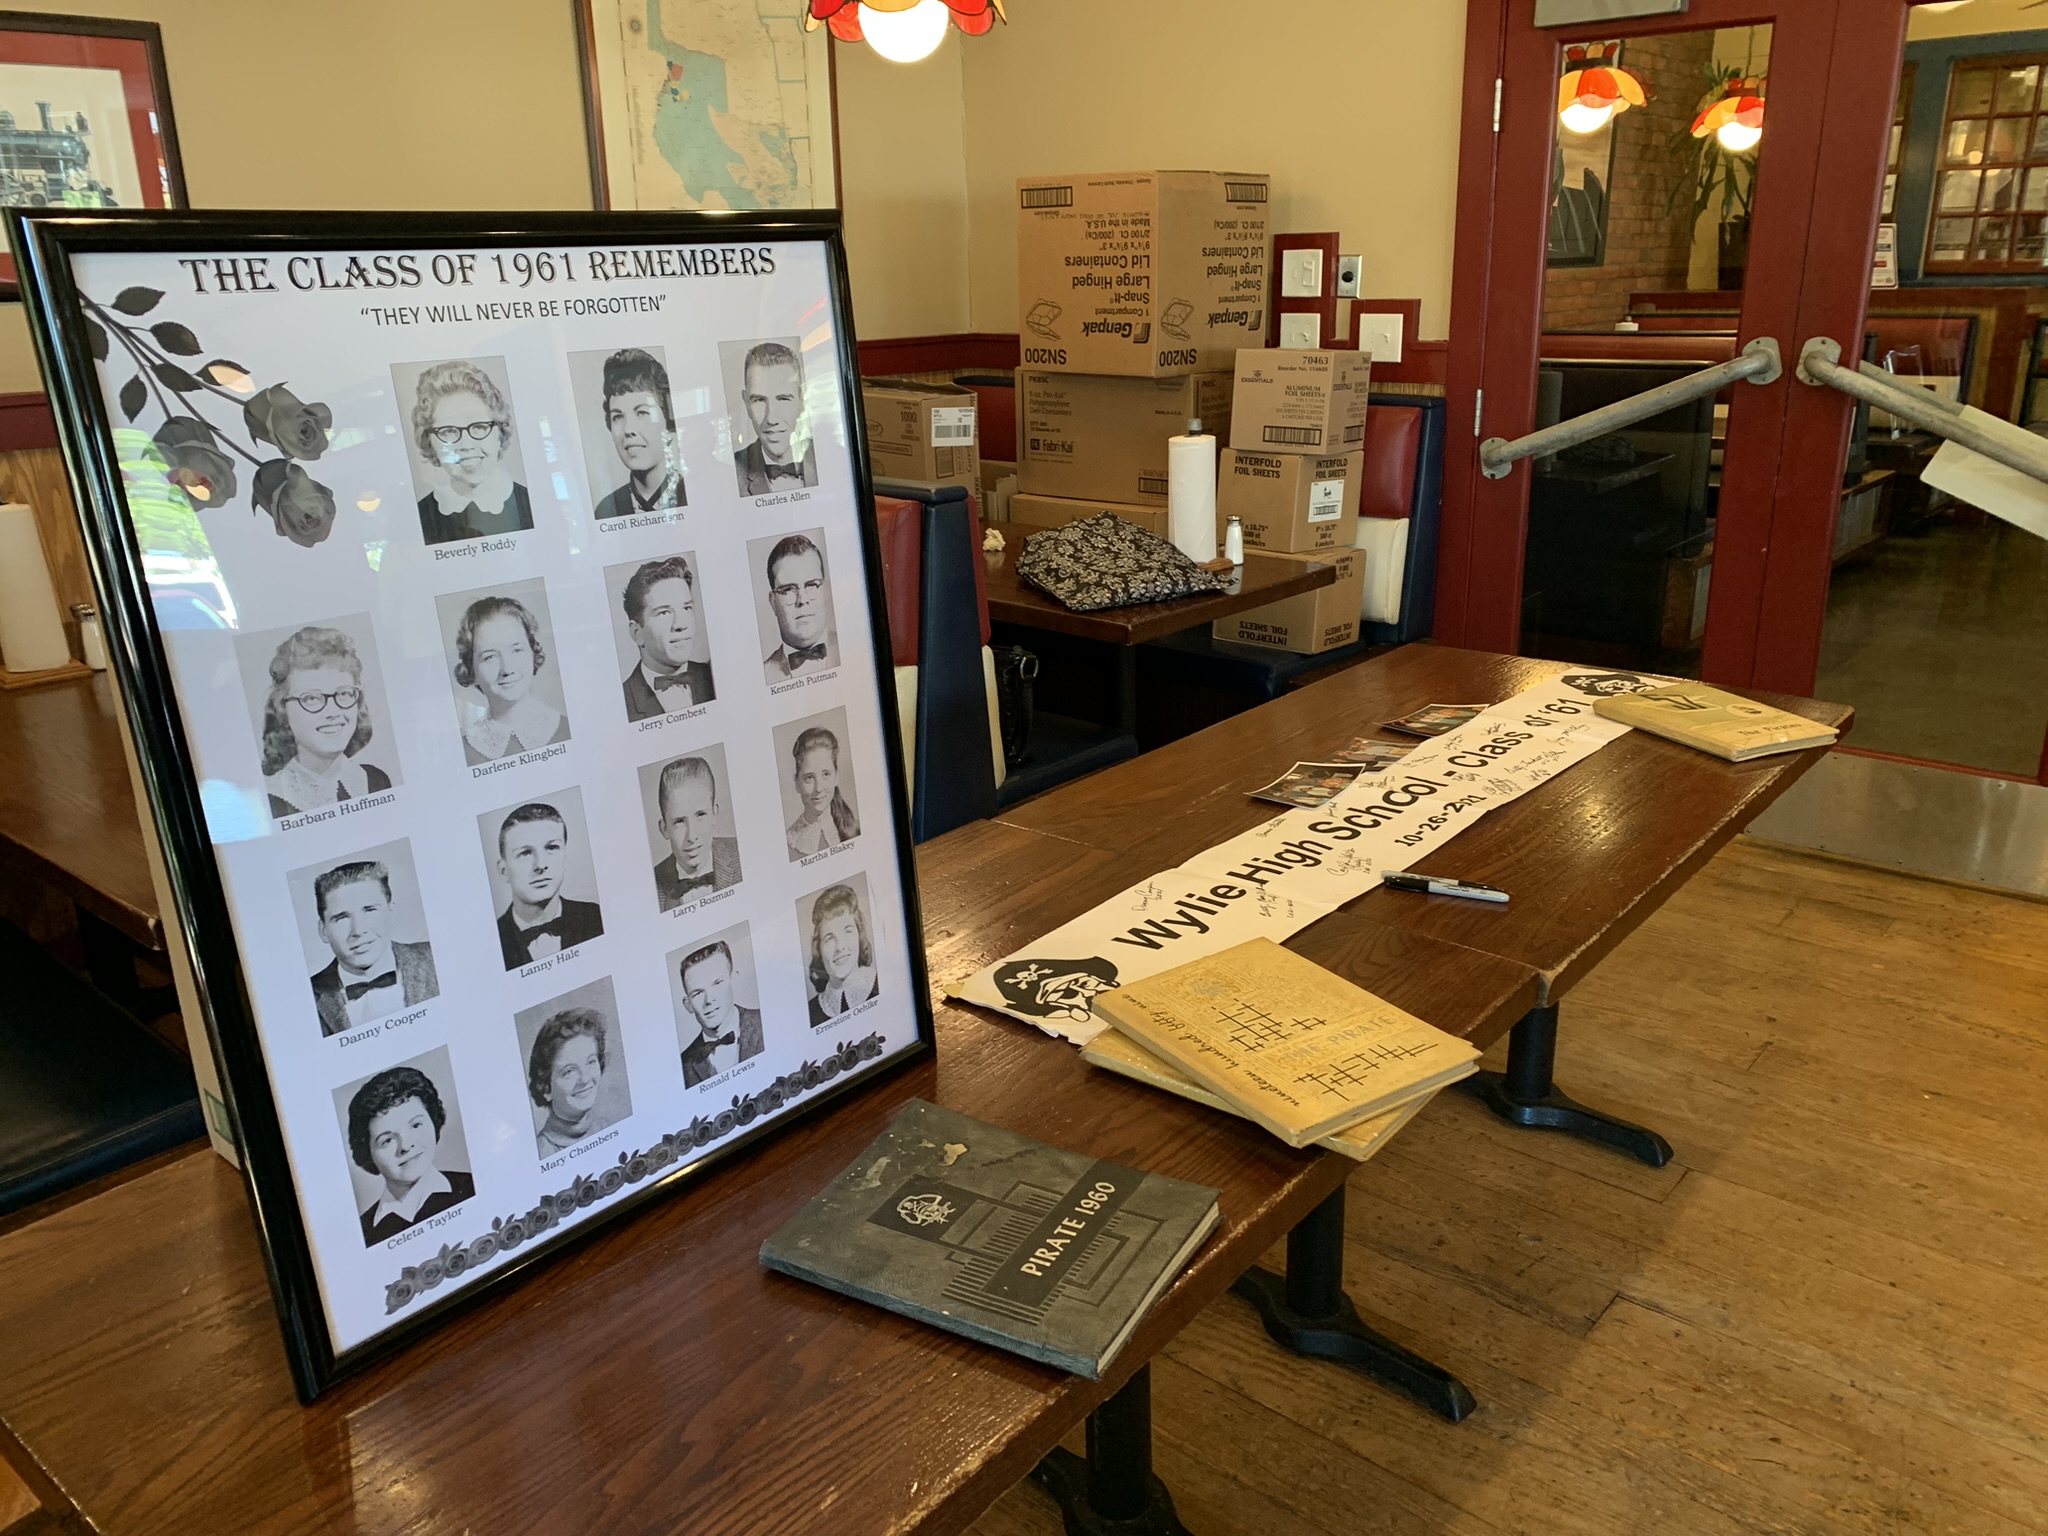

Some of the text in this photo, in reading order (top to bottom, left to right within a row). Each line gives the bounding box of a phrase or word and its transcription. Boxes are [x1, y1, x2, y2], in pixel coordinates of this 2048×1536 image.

[1108, 219, 1120, 227] the
[1121, 219, 1129, 227] in
[1130, 218, 1150, 227] Made
[1130, 230, 1150, 239] 2/100
[1064, 254, 1150, 269] Lid Containers
[1202, 246, 1264, 259] Lid Containers
[178, 247, 777, 294] THE CLASS OF 1961 REMEMBERS
[1207, 264, 1263, 278] Large Hinged
[1072, 275, 1150, 290] Large Hinged
[1218, 295, 1257, 305] Compartment
[361, 294, 667, 327] “THEY WILL NEVER BE FORGOTTEN”
[1095, 306, 1150, 318] 1 Compartment
[1208, 310, 1248, 328] Genpak
[1082, 321, 1133, 338] Genpak
[1024, 348, 1068, 366] SN200
[1159, 349, 1197, 367] SN200
[1302, 356, 1329, 365] 70463
[1042, 407, 1072, 416] Containers
[1235, 456, 1281, 468] INTERFOLD
[1316, 458, 1348, 469] INTERFOLD
[1234, 466, 1280, 479] FOIL SHEETS
[1315, 469, 1347, 479] FOIL SHEETS
[755, 491, 811, 508] Charles Allen
[599, 510, 685, 534] Carol Richardson
[434, 537, 517, 562] Beverly Roddy
[1239, 620, 1288, 636] FOIL SHEETS
[1324, 622, 1352, 637] FOIL SHEETS
[1238, 631, 1287, 646] INTERFOLD
[1323, 632, 1352, 647] INTERFOLD
[769, 670, 838, 696] Kenneth Putman
[638, 706, 707, 733] Jerry Combest
[472, 743, 567, 780] Darlene Klingbeil
[280, 792, 396, 832] Barbara Huffman
[1111, 883, 1247, 950] Wylie
[1226, 839, 1334, 885] High
[1308, 776, 1449, 841] School
[1446, 731, 1534, 769] Class
[1524, 712, 1561, 727] of
[800, 840, 856, 868] Martha Blakey
[673, 888, 735, 919] Larry Bozman
[519, 948, 580, 979] Lanny Hale
[815, 998, 879, 1037] Ernestine Oehlke
[338, 1007, 428, 1048] Danny Cooper
[1327, 1015, 1395, 1045] PIRATE
[1121, 993, 1300, 1108] nineteen hundred fifty nine
[698, 1060, 756, 1095] Ronald Lewis
[539, 1129, 619, 1175] Mary Chambers
[386, 1206, 464, 1250] Celeta Taylor
[1020, 1181, 1117, 1277] PIRATE 1960
